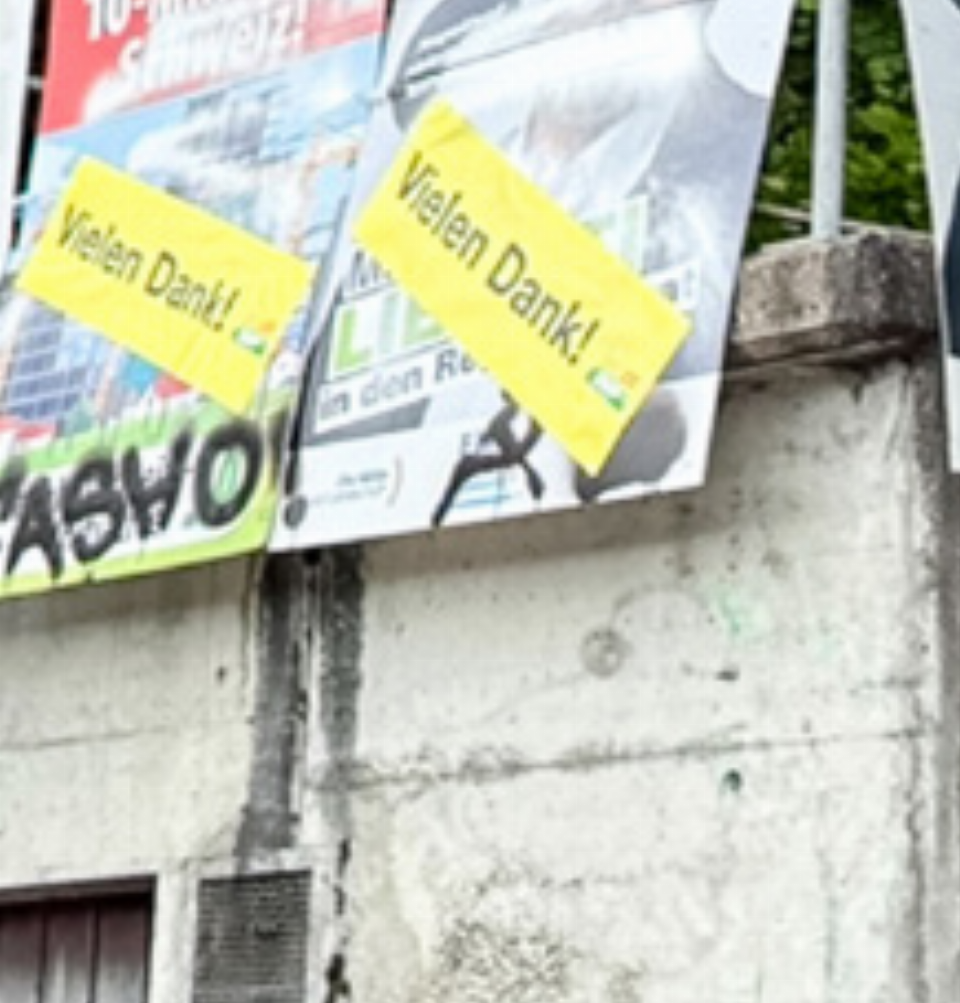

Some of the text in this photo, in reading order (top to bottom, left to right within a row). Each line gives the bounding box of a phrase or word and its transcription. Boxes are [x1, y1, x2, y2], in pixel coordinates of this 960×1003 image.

[55, 203, 140, 282] Vielen
[143, 249, 240, 333] Dank!
[396, 149, 490, 271] Vielen
[485, 243, 601, 367] Dank!
[360, 359, 424, 409] den
